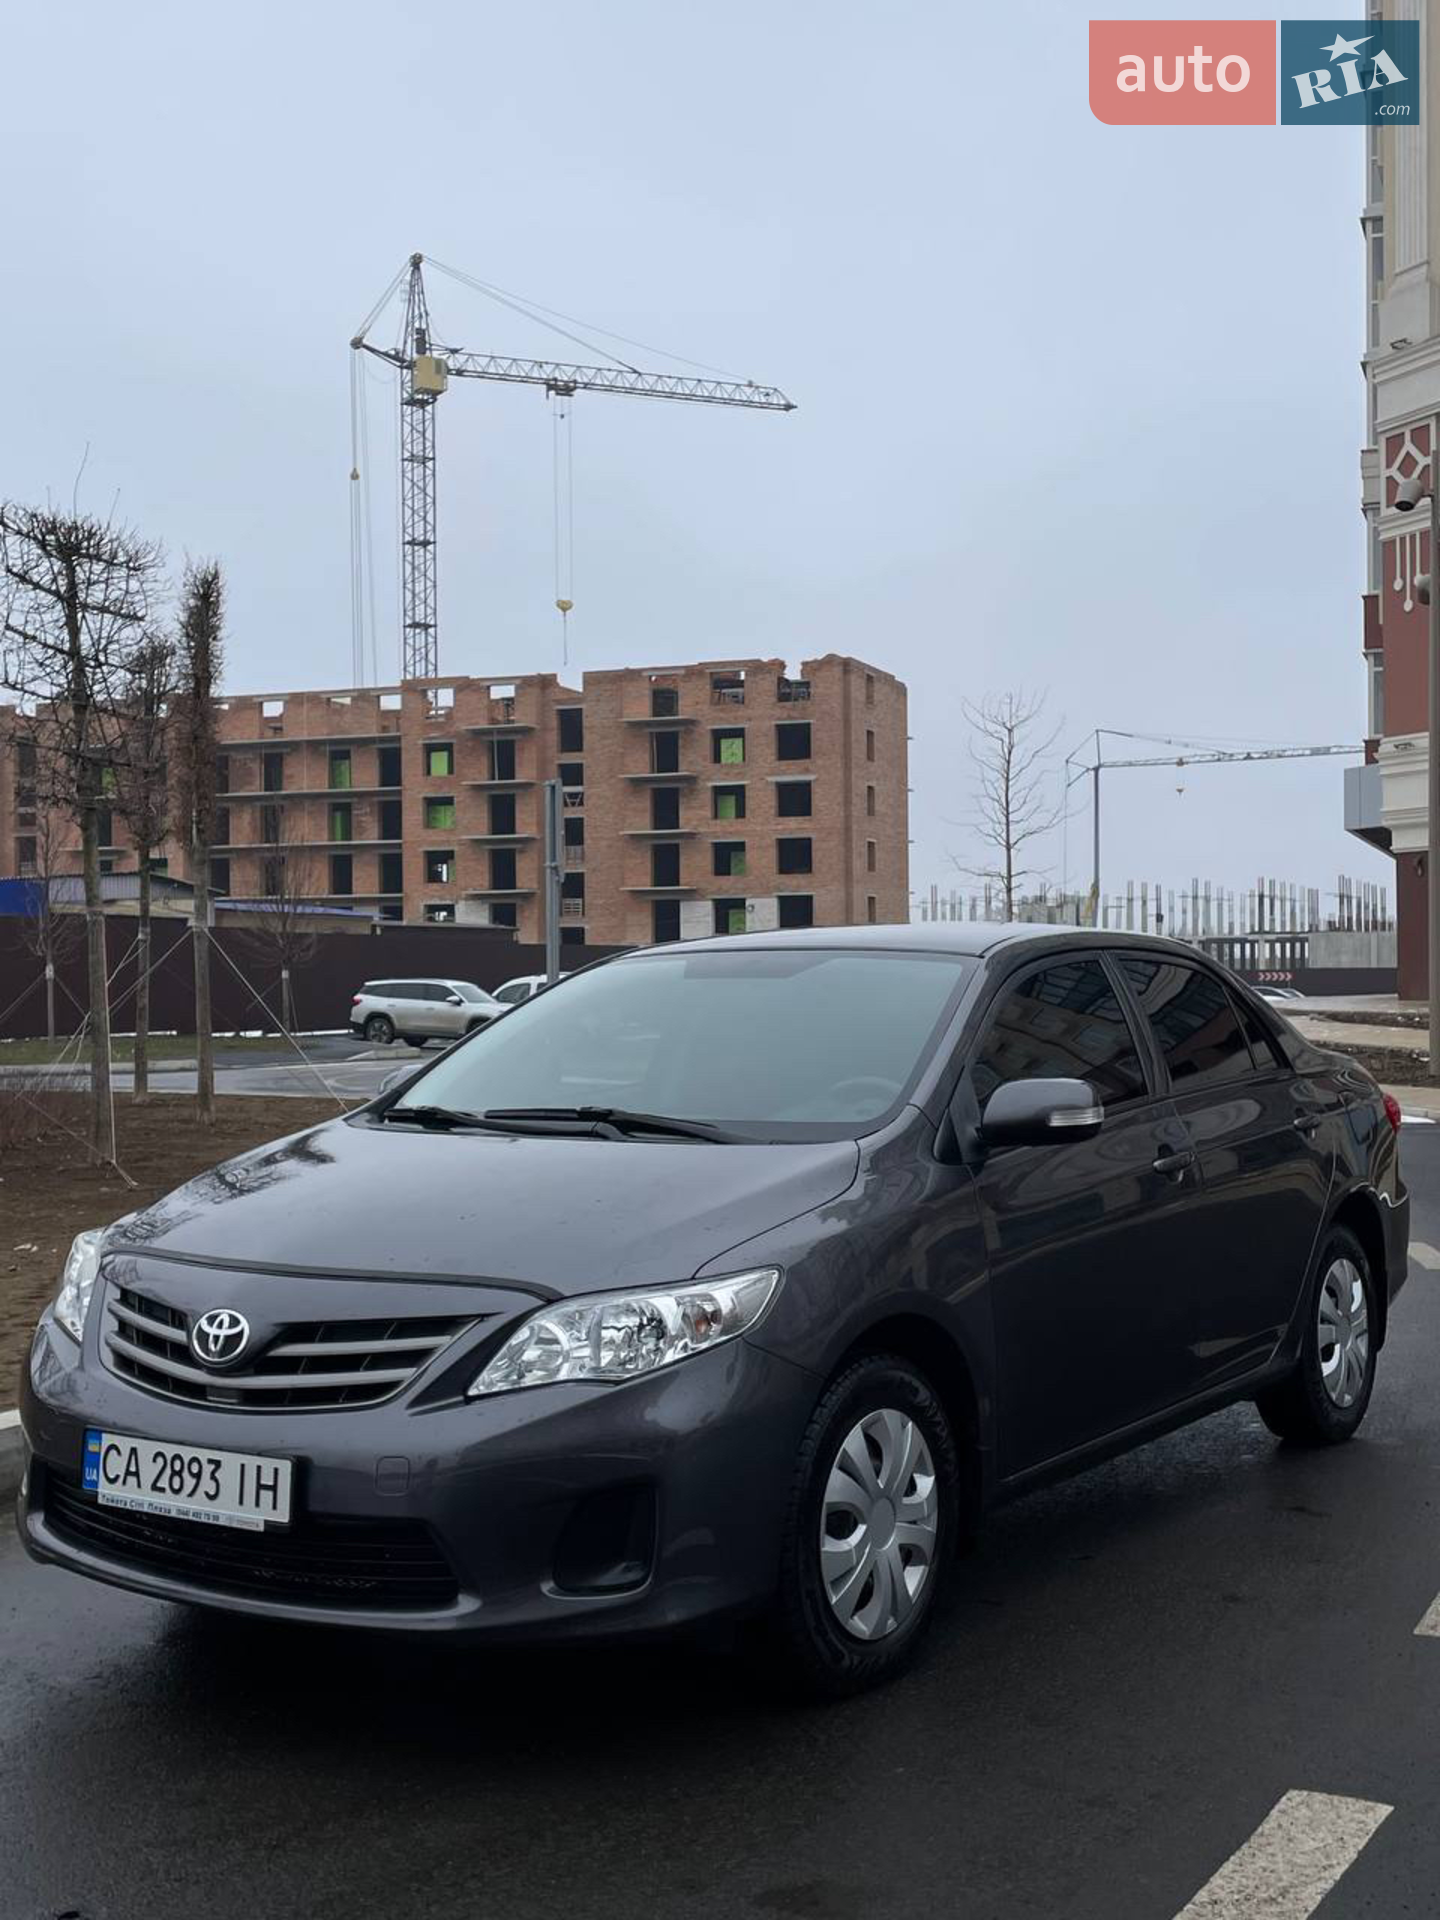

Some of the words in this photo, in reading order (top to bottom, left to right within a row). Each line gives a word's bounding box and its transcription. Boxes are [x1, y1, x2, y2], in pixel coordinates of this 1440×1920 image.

[85, 1467, 98, 1482] UA
[102, 1443, 142, 1489] CA
[150, 1451, 222, 1501] 2893
[238, 1462, 279, 1511] IH
